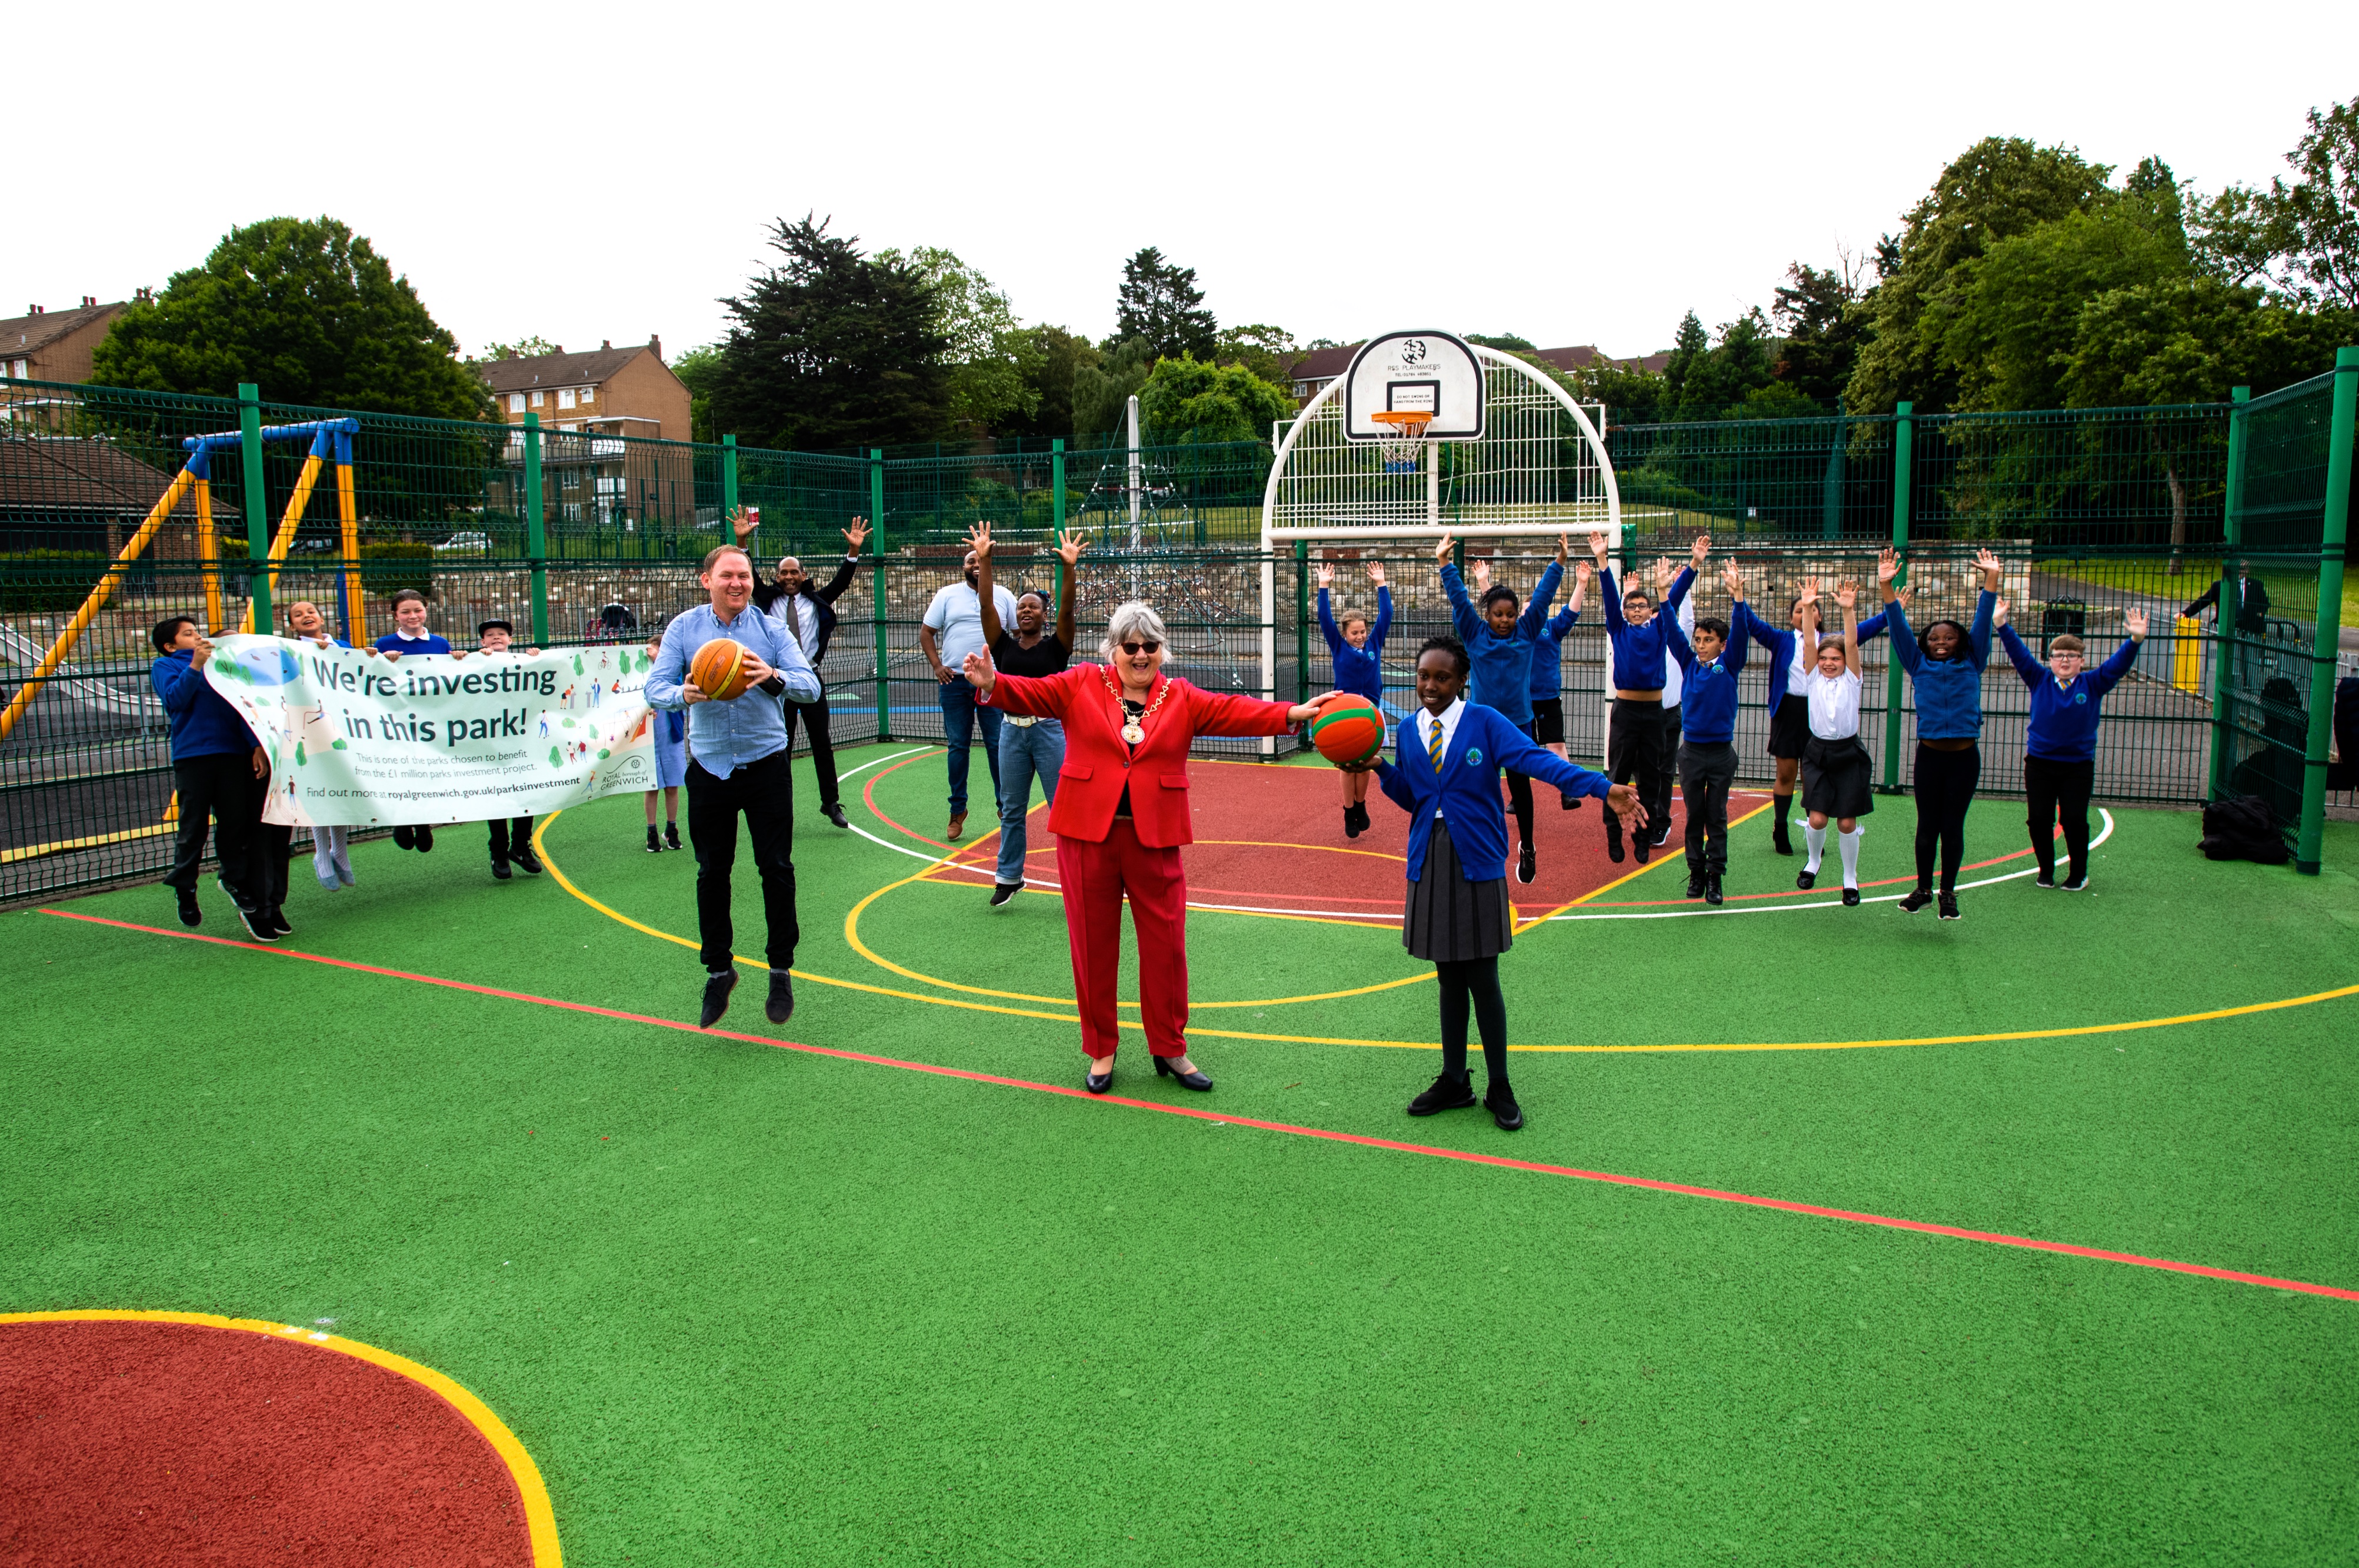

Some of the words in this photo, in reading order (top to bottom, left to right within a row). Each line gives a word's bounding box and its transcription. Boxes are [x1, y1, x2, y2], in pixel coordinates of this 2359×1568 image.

[694, 646, 714, 676] molten
[312, 656, 397, 696] We're
[406, 664, 557, 696] investing
[343, 708, 373, 739] in
[379, 713, 436, 742] this
[447, 708, 527, 747] park!
[356, 752, 372, 763] This
[374, 755, 381, 763] is
[401, 755, 408, 764] of
[427, 756, 448, 766] parks
[451, 755, 482, 764] chosen
[498, 749, 528, 760] benefit
[355, 766, 372, 777] from
[373, 769, 386, 778] the
[388, 769, 397, 778] £1
[401, 769, 428, 778] million
[430, 769, 451, 780] parks
[454, 767, 501, 777] investment
[503, 763, 537, 776] project.
[602, 772, 621, 783] ROYAL
[307, 787, 325, 797] Find
[388, 776, 581, 800] royalgreenwich.gov.uk/parksinvestment
[601, 776, 648, 790] GREENWICH
